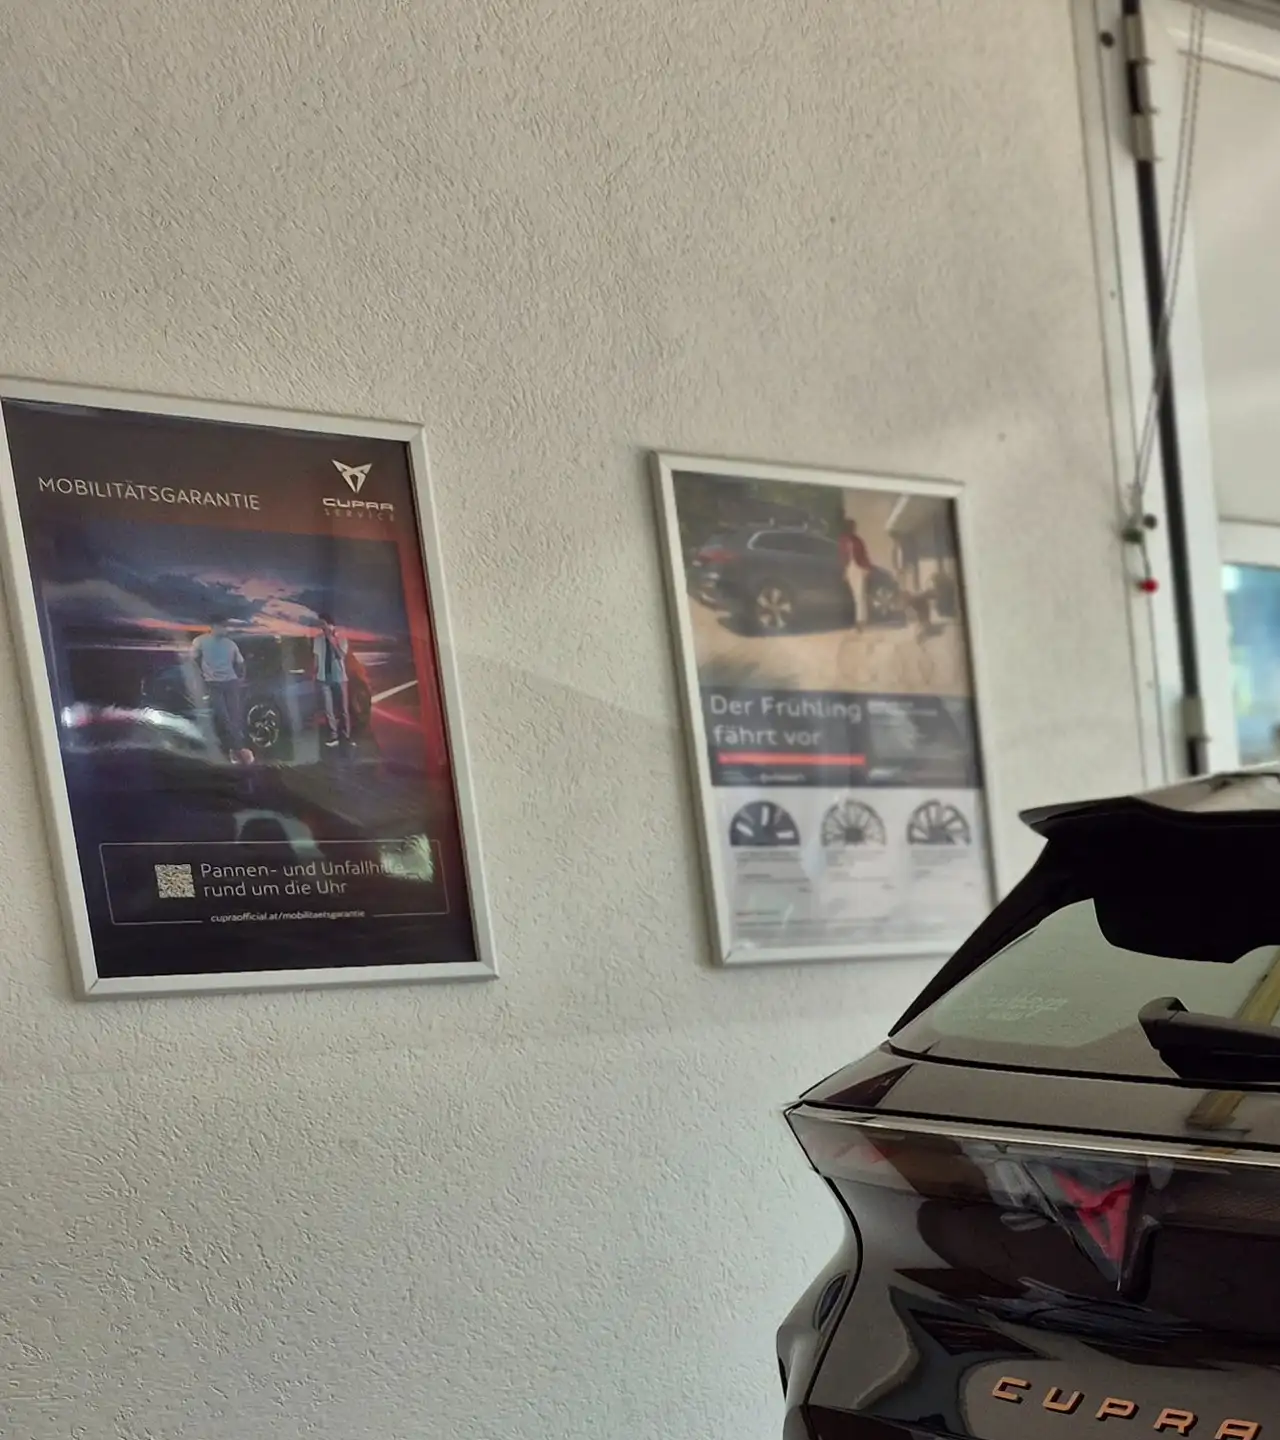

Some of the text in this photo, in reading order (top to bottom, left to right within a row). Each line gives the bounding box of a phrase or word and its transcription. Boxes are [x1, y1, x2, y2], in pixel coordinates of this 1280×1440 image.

[38, 477, 260, 511] MOBILITÄTSGARANTIE
[322, 497, 394, 512] CUPRA
[710, 695, 754, 716] Der
[761, 696, 862, 724] Frühling
[712, 723, 822, 746] fährt vor
[200, 862, 277, 878] Pannen-
[283, 861, 316, 877] und
[203, 879, 349, 898] rund um die Uhr
